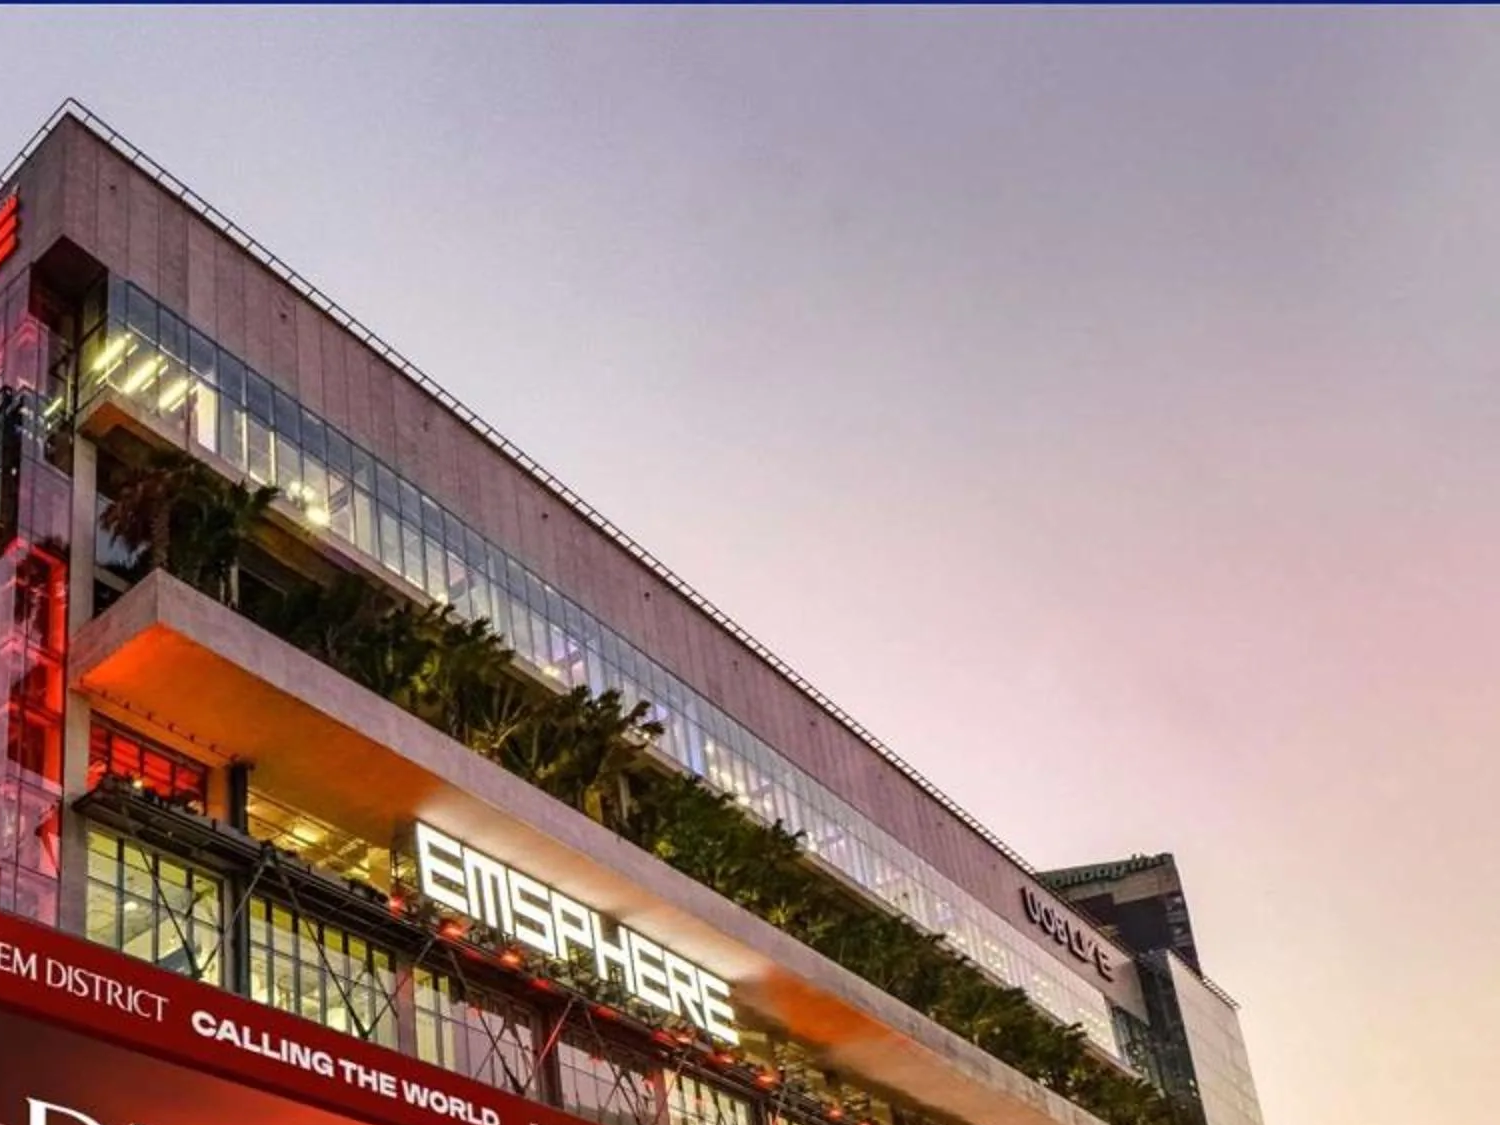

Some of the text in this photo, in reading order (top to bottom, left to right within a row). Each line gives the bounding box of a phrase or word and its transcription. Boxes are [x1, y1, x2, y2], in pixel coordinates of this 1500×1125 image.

[416, 821, 740, 1046] EMSPHERE
[46, 958, 169, 1022] DISTRICT
[191, 1010, 335, 1078] CALLING
[338, 1058, 397, 1099] THE
